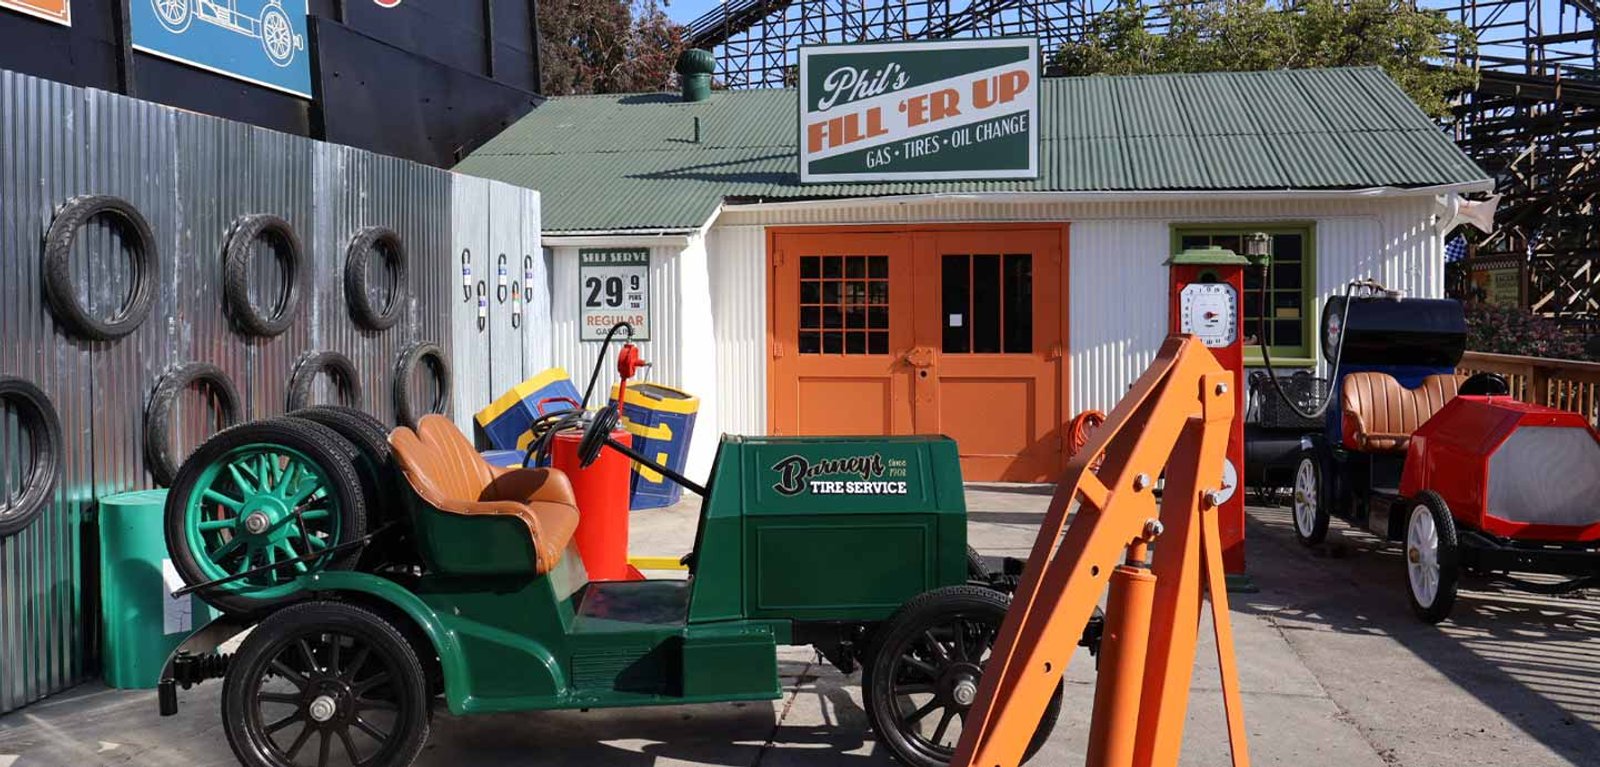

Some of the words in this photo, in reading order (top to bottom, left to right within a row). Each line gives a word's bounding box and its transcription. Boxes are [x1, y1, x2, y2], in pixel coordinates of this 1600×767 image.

[818, 62, 911, 111] Phil's
[808, 106, 889, 154] FILL
[898, 88, 962, 127] 'ER
[971, 69, 1030, 109] UP
[866, 146, 891, 168] GAS
[903, 135, 941, 160] TIRES
[951, 128, 973, 148] OIL
[976, 114, 1028, 143] CHANGE
[582, 252, 606, 262] SELF
[610, 252, 647, 262] SERVE
[585, 276, 623, 307] 29
[630, 275, 640, 290] 9
[587, 315, 644, 326] REGULAR
[771, 453, 886, 497] Barney's
[810, 481, 844, 494] TIRE
[845, 481, 907, 494] SERVICE
